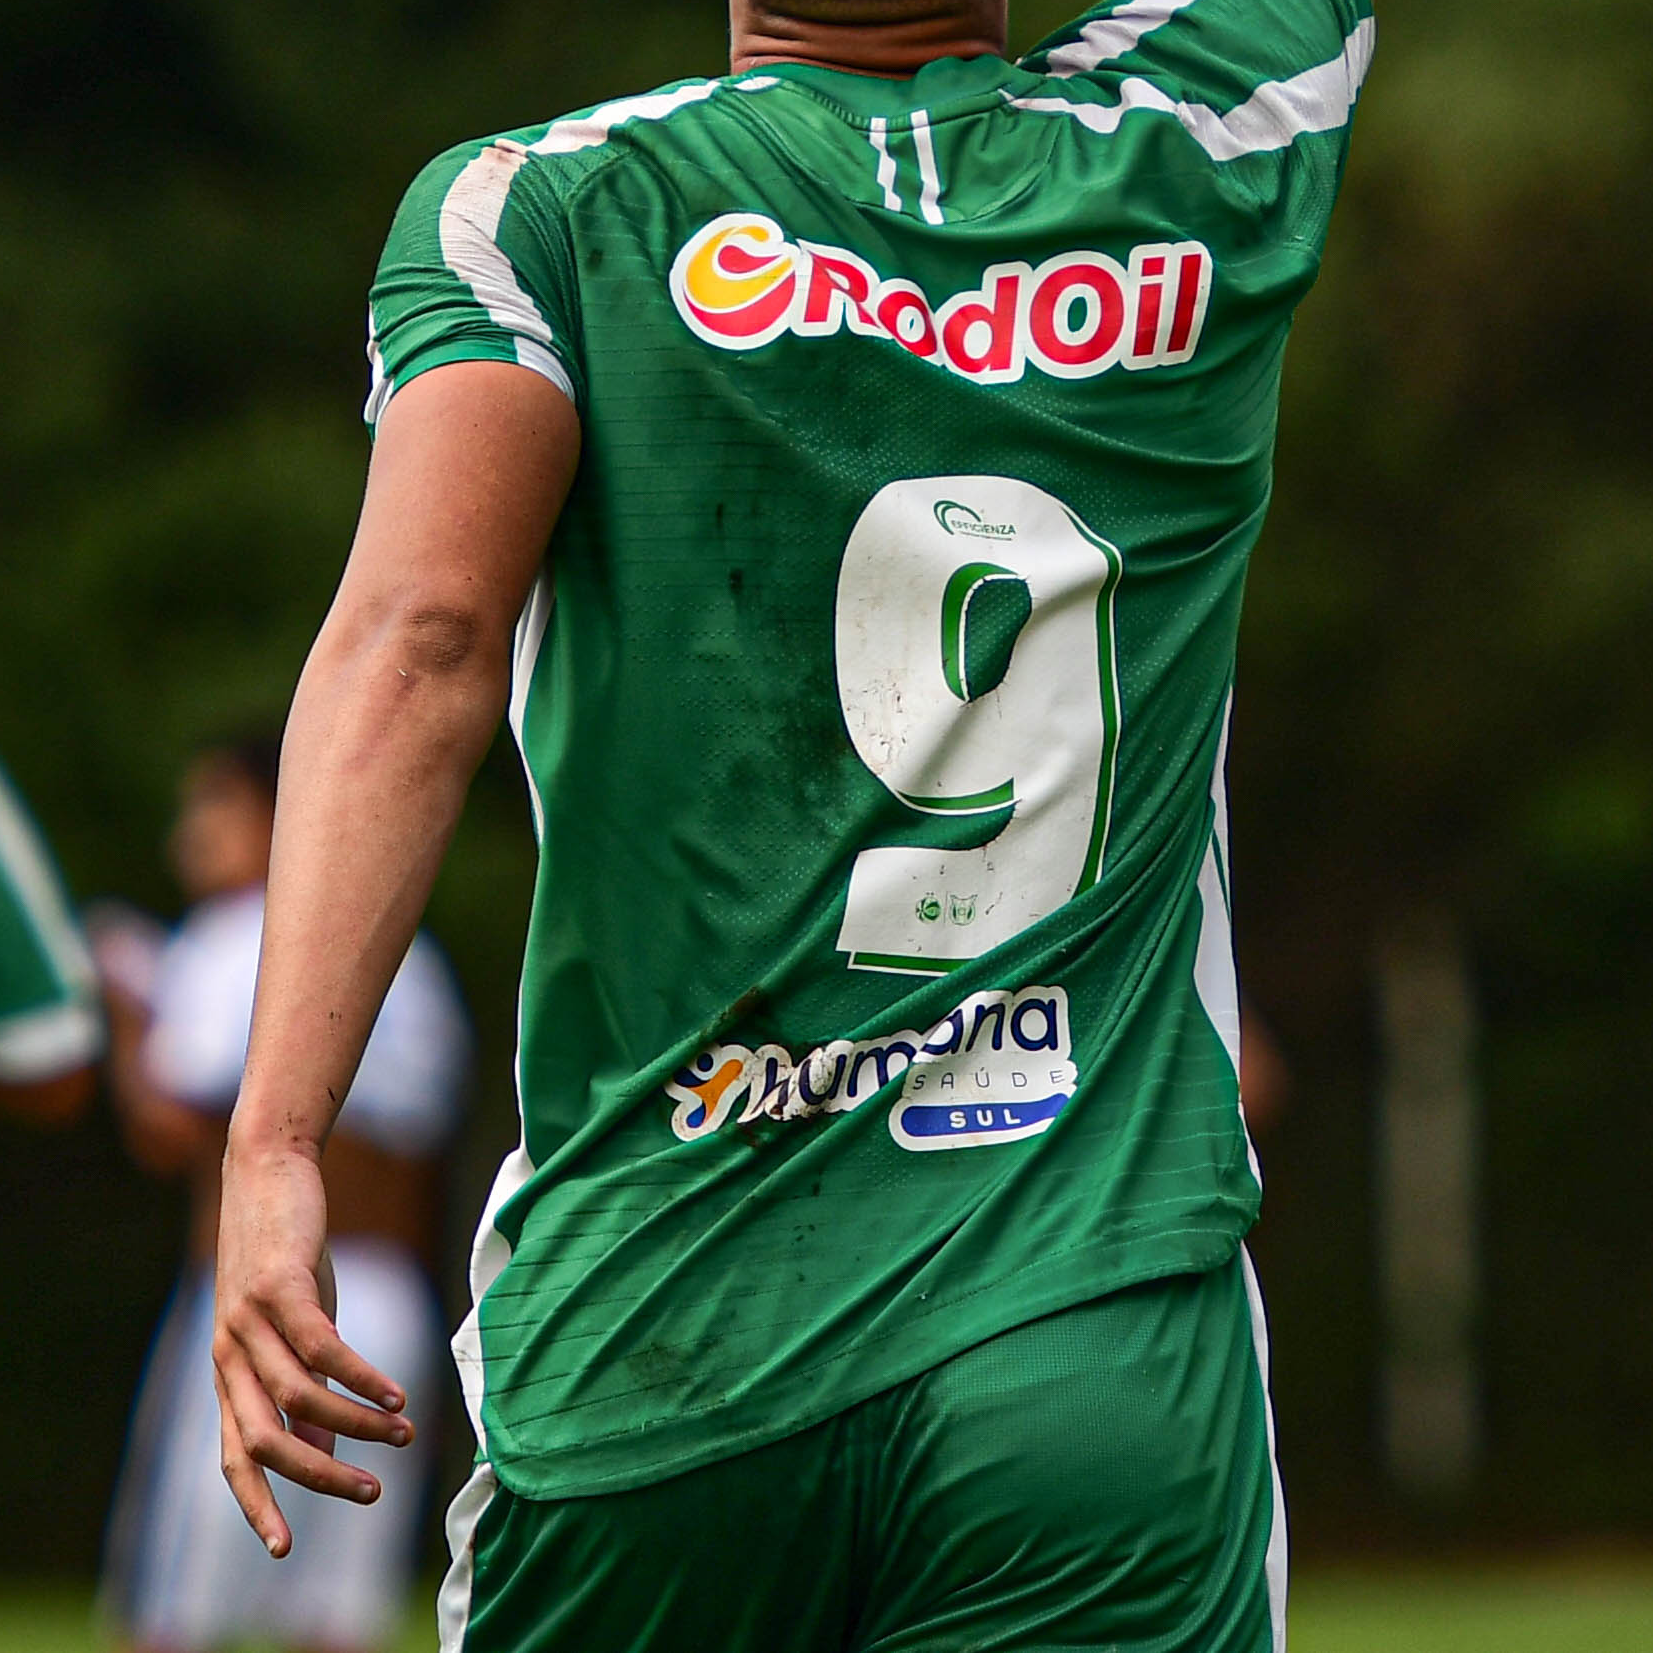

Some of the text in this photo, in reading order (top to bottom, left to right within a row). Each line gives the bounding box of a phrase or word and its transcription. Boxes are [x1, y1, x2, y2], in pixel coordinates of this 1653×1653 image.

[797, 245, 1207, 377] RodOil
[835, 474, 1123, 975] 9
[750, 997, 1059, 1119] humana
[912, 1066, 1065, 1091] SAÚDE
[949, 1108, 1021, 1128] SUL
